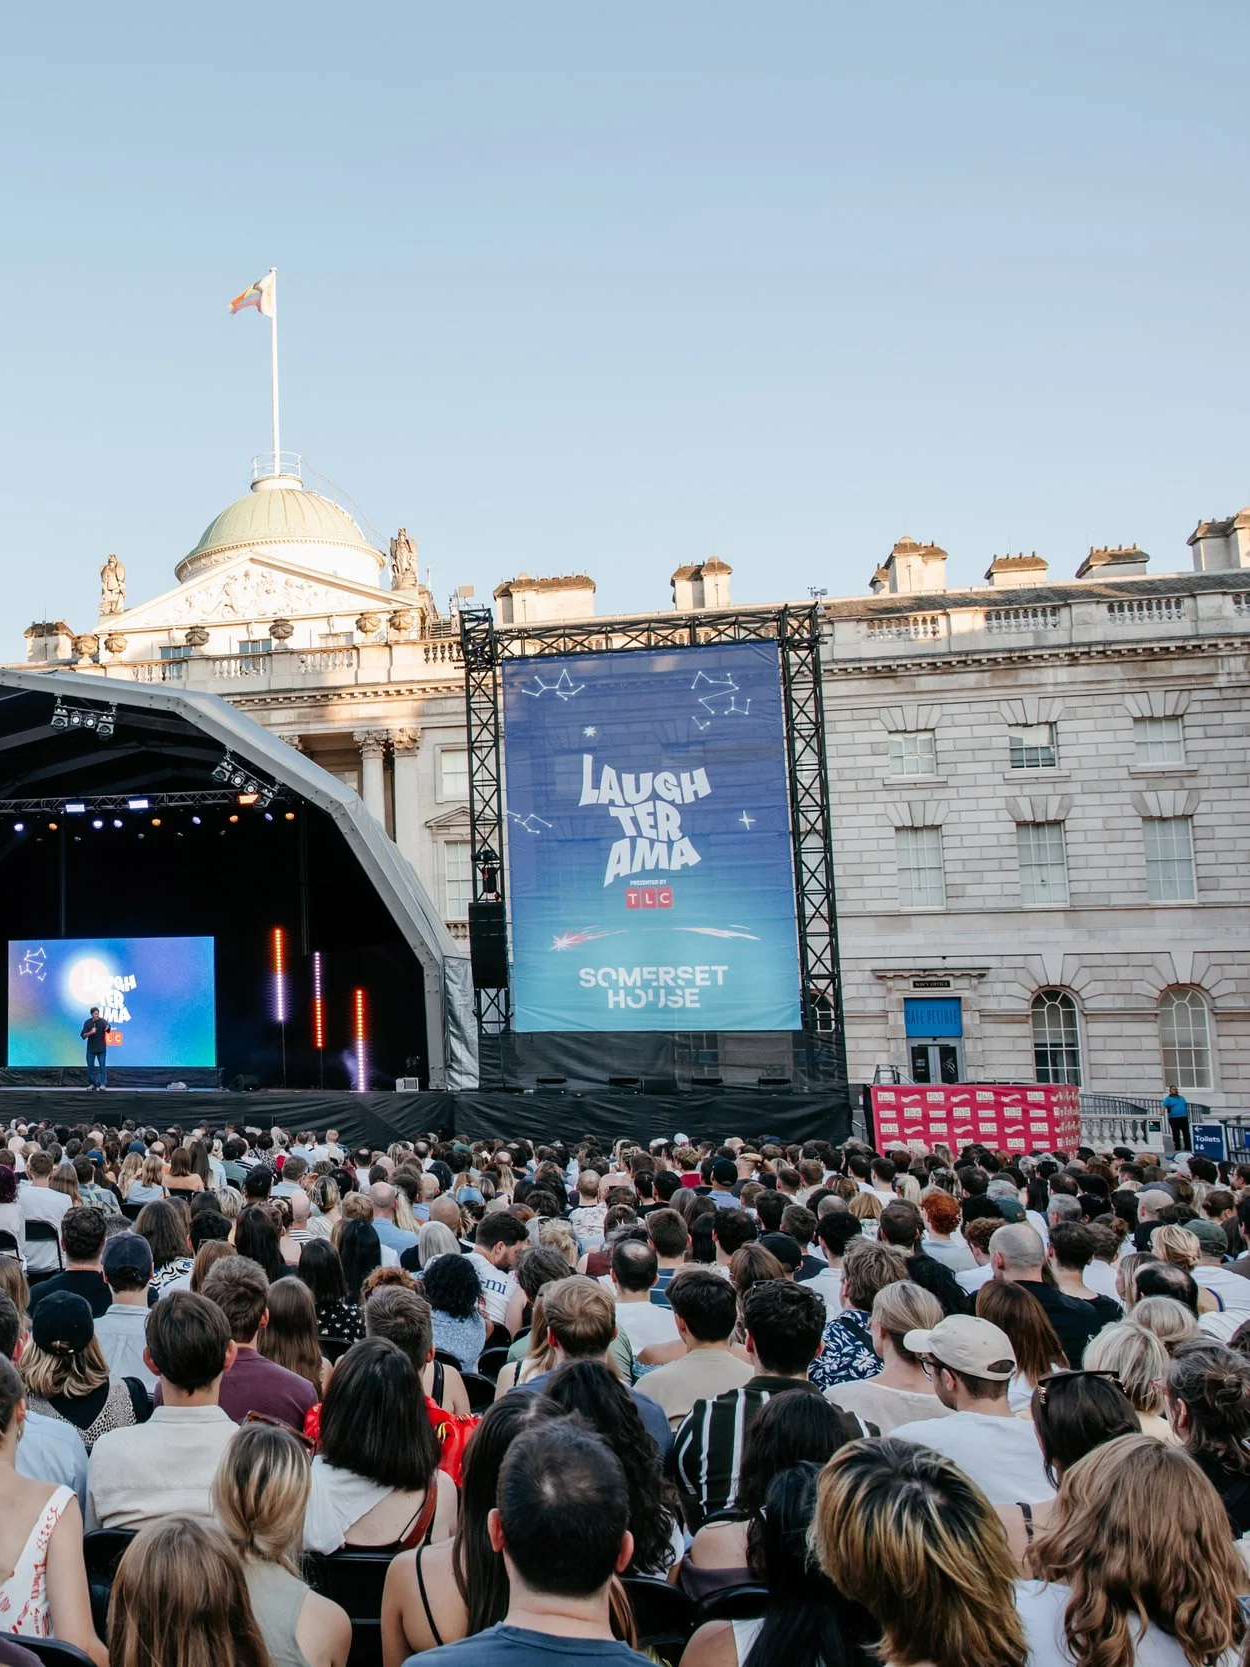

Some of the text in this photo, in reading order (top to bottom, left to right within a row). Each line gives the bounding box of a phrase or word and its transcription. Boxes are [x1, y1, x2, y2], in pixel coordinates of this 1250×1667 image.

[578, 754, 712, 807] LAUGH
[608, 800, 683, 841] TER
[603, 836, 702, 888] AMA
[627, 892, 671, 905] TLC
[579, 965, 729, 988] SOMERSET
[607, 988, 701, 1009] HOUSE
[1194, 1135, 1221, 1143] Toilets
